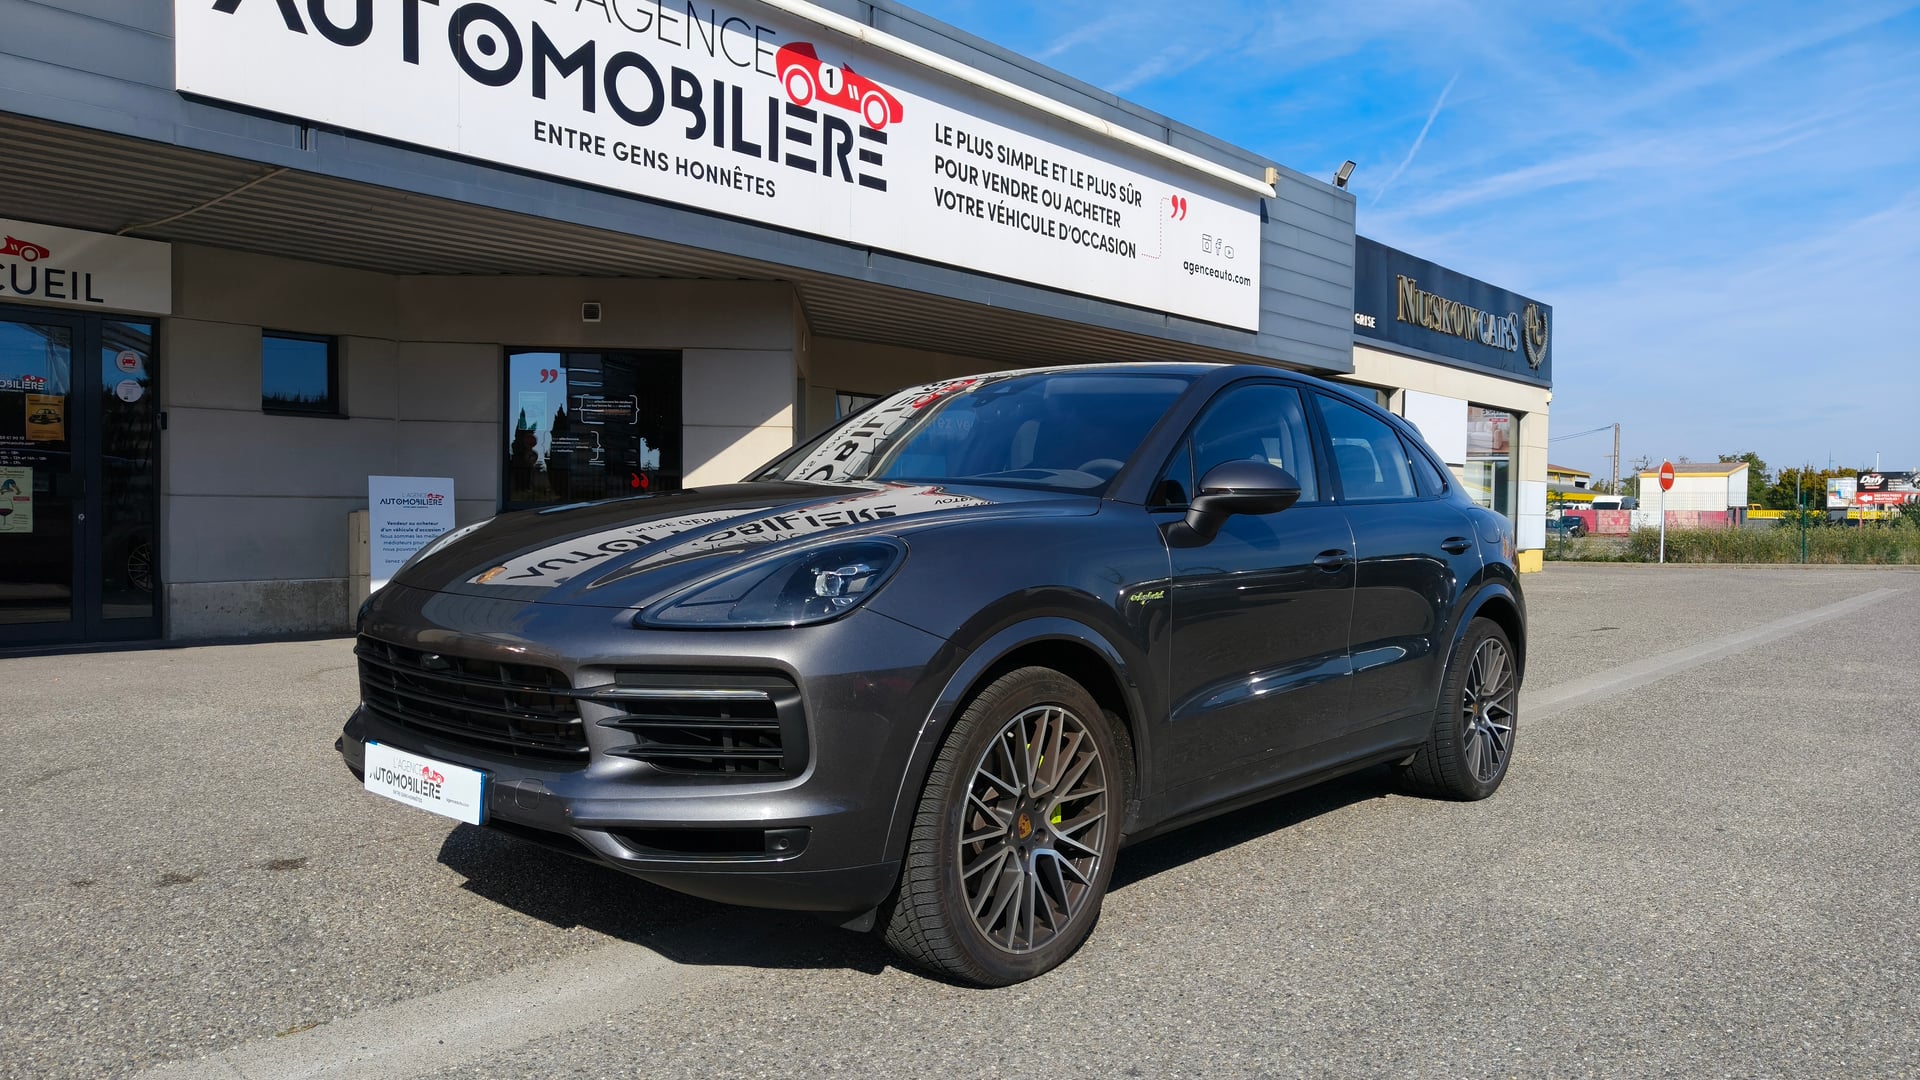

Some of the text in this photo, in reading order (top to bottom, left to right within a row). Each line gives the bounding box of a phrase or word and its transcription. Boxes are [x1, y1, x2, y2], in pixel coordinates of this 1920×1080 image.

[545, 0, 776, 78] GENCE
[534, 120, 775, 198] ENTRE GENS HONNÊTES
[935, 123, 1142, 207] LE PLUS SIMPLE ET LE PLUS SÛR
[935, 155, 1121, 228] POUR VENDRE OU ACHETER
[934, 187, 1136, 259] VOTRE VÉHICULE D'OCCASION
[1183, 260, 1251, 286] agenceauto.com
[1354, 313, 1376, 328] GRISE
[1860, 476, 1885, 486] Dafy
